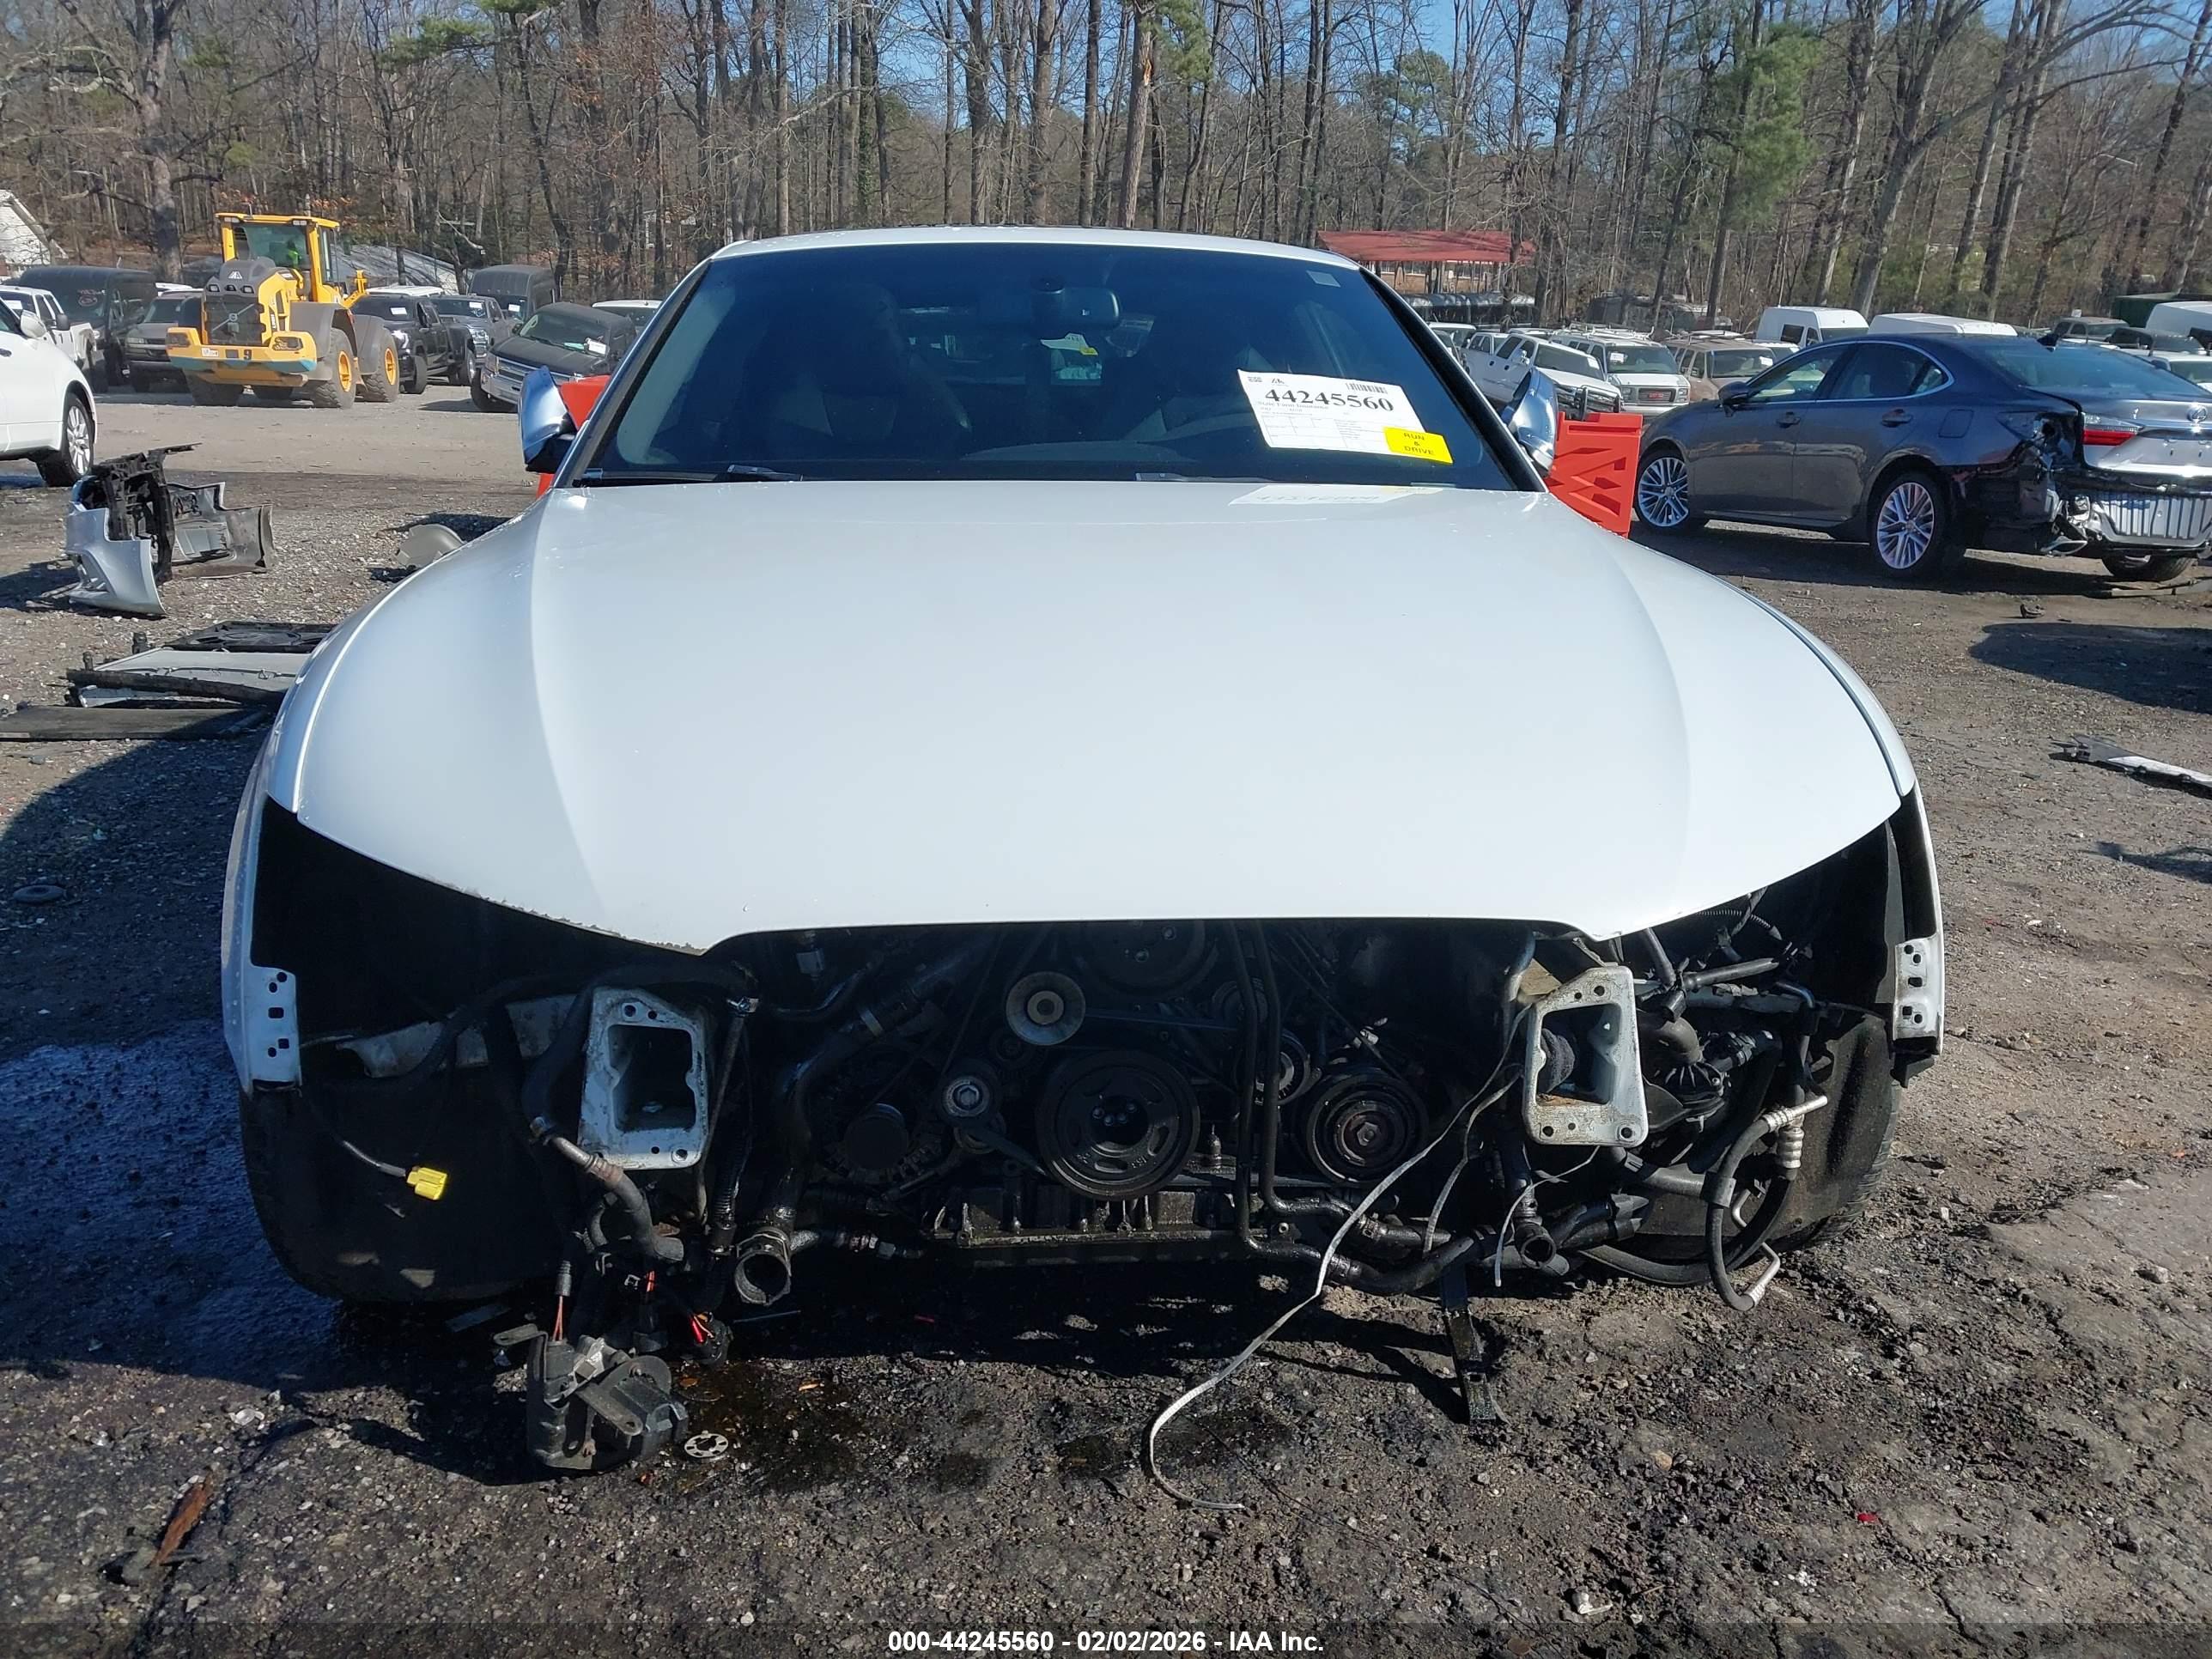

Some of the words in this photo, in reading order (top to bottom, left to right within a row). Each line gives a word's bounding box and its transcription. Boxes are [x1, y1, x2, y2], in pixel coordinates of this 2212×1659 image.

[1266, 389, 1394, 411] 44245560
[1403, 432, 1425, 441] RUN
[1404, 446, 1434, 455] DRIVE
